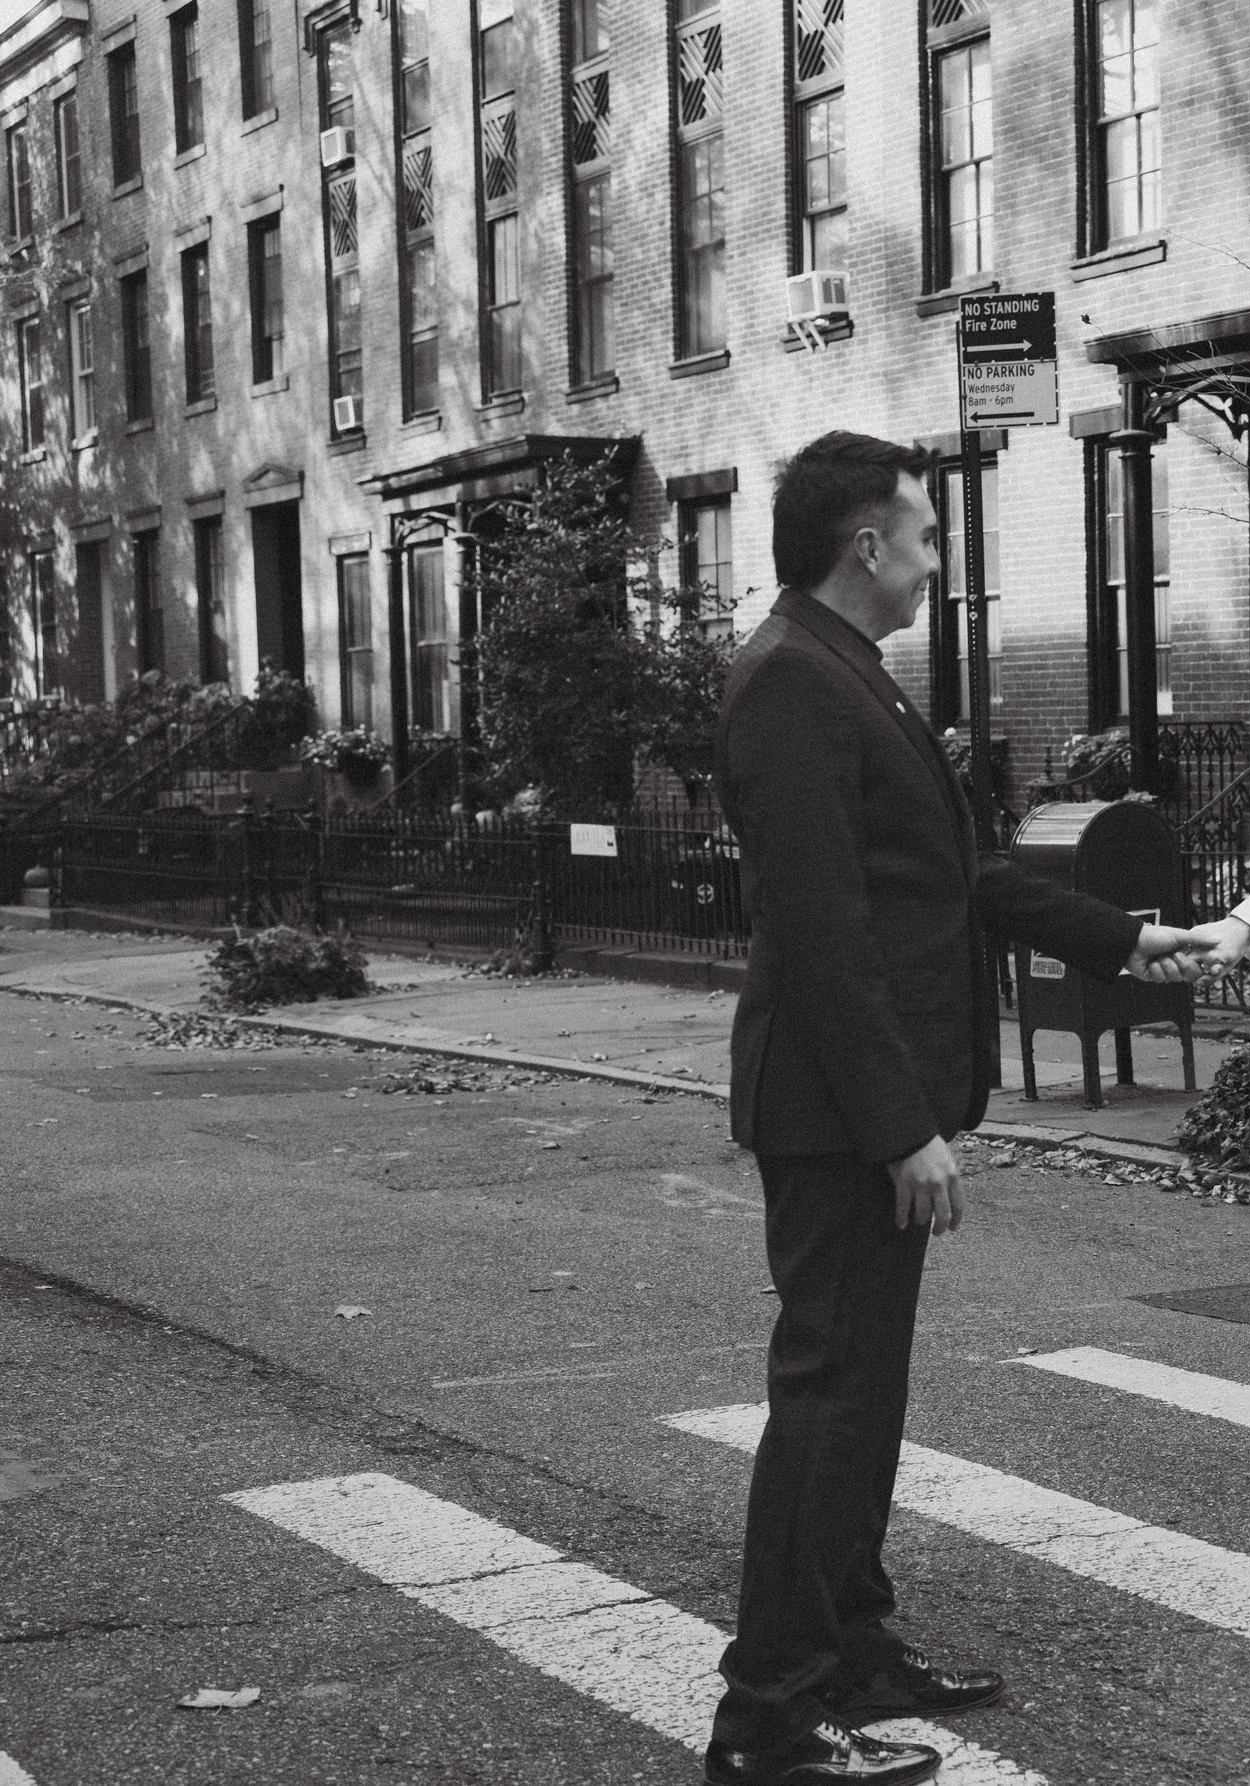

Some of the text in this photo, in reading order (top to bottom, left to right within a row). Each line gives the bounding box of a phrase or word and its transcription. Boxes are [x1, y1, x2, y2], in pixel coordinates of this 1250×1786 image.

[965, 299, 1040, 316] NO STANDING
[965, 318, 1017, 332] Fire Zone
[967, 364, 1035, 379] NO PARKING
[968, 382, 1015, 394] Wednesday
[968, 396, 987, 406] 8am
[995, 395, 1014, 406] 6pm
